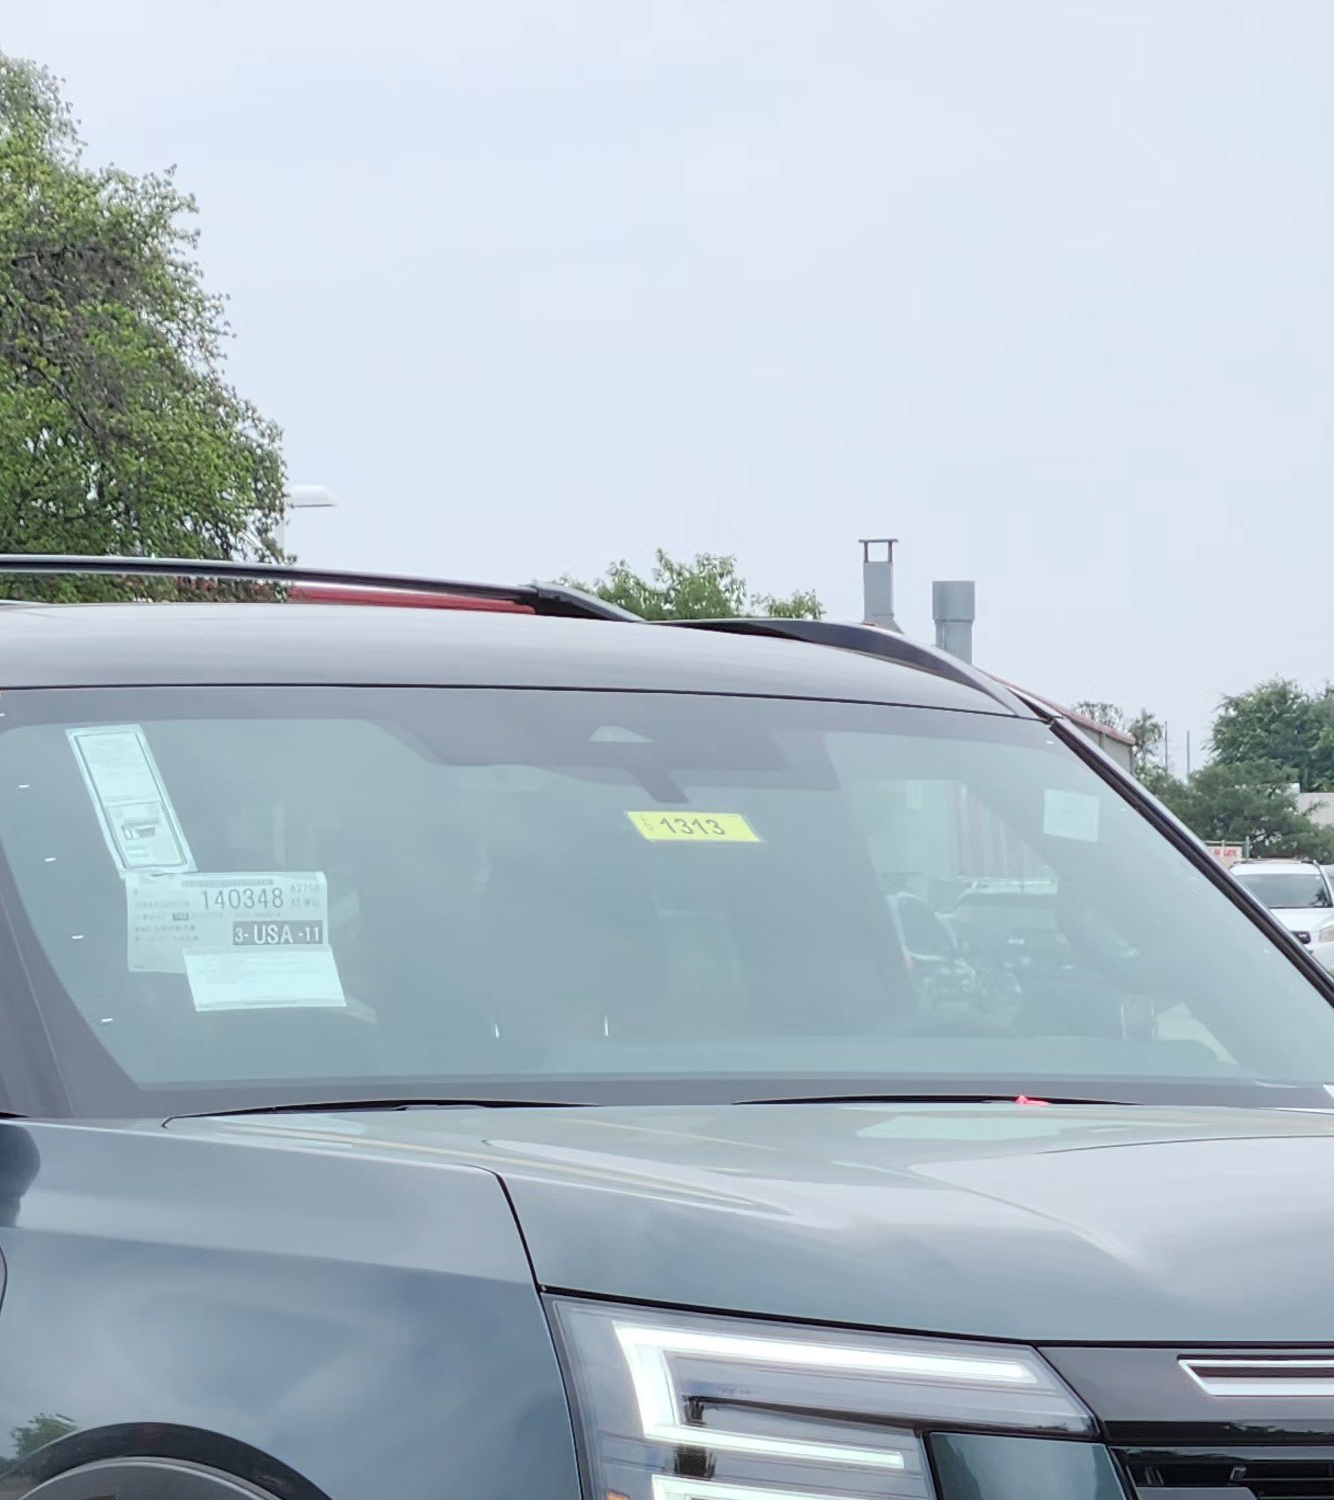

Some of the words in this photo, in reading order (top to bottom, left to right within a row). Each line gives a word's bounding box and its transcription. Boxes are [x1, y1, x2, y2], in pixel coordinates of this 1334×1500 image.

[660, 818, 725, 835] 1313
[202, 887, 284, 911] 140348
[254, 924, 293, 945] USA
